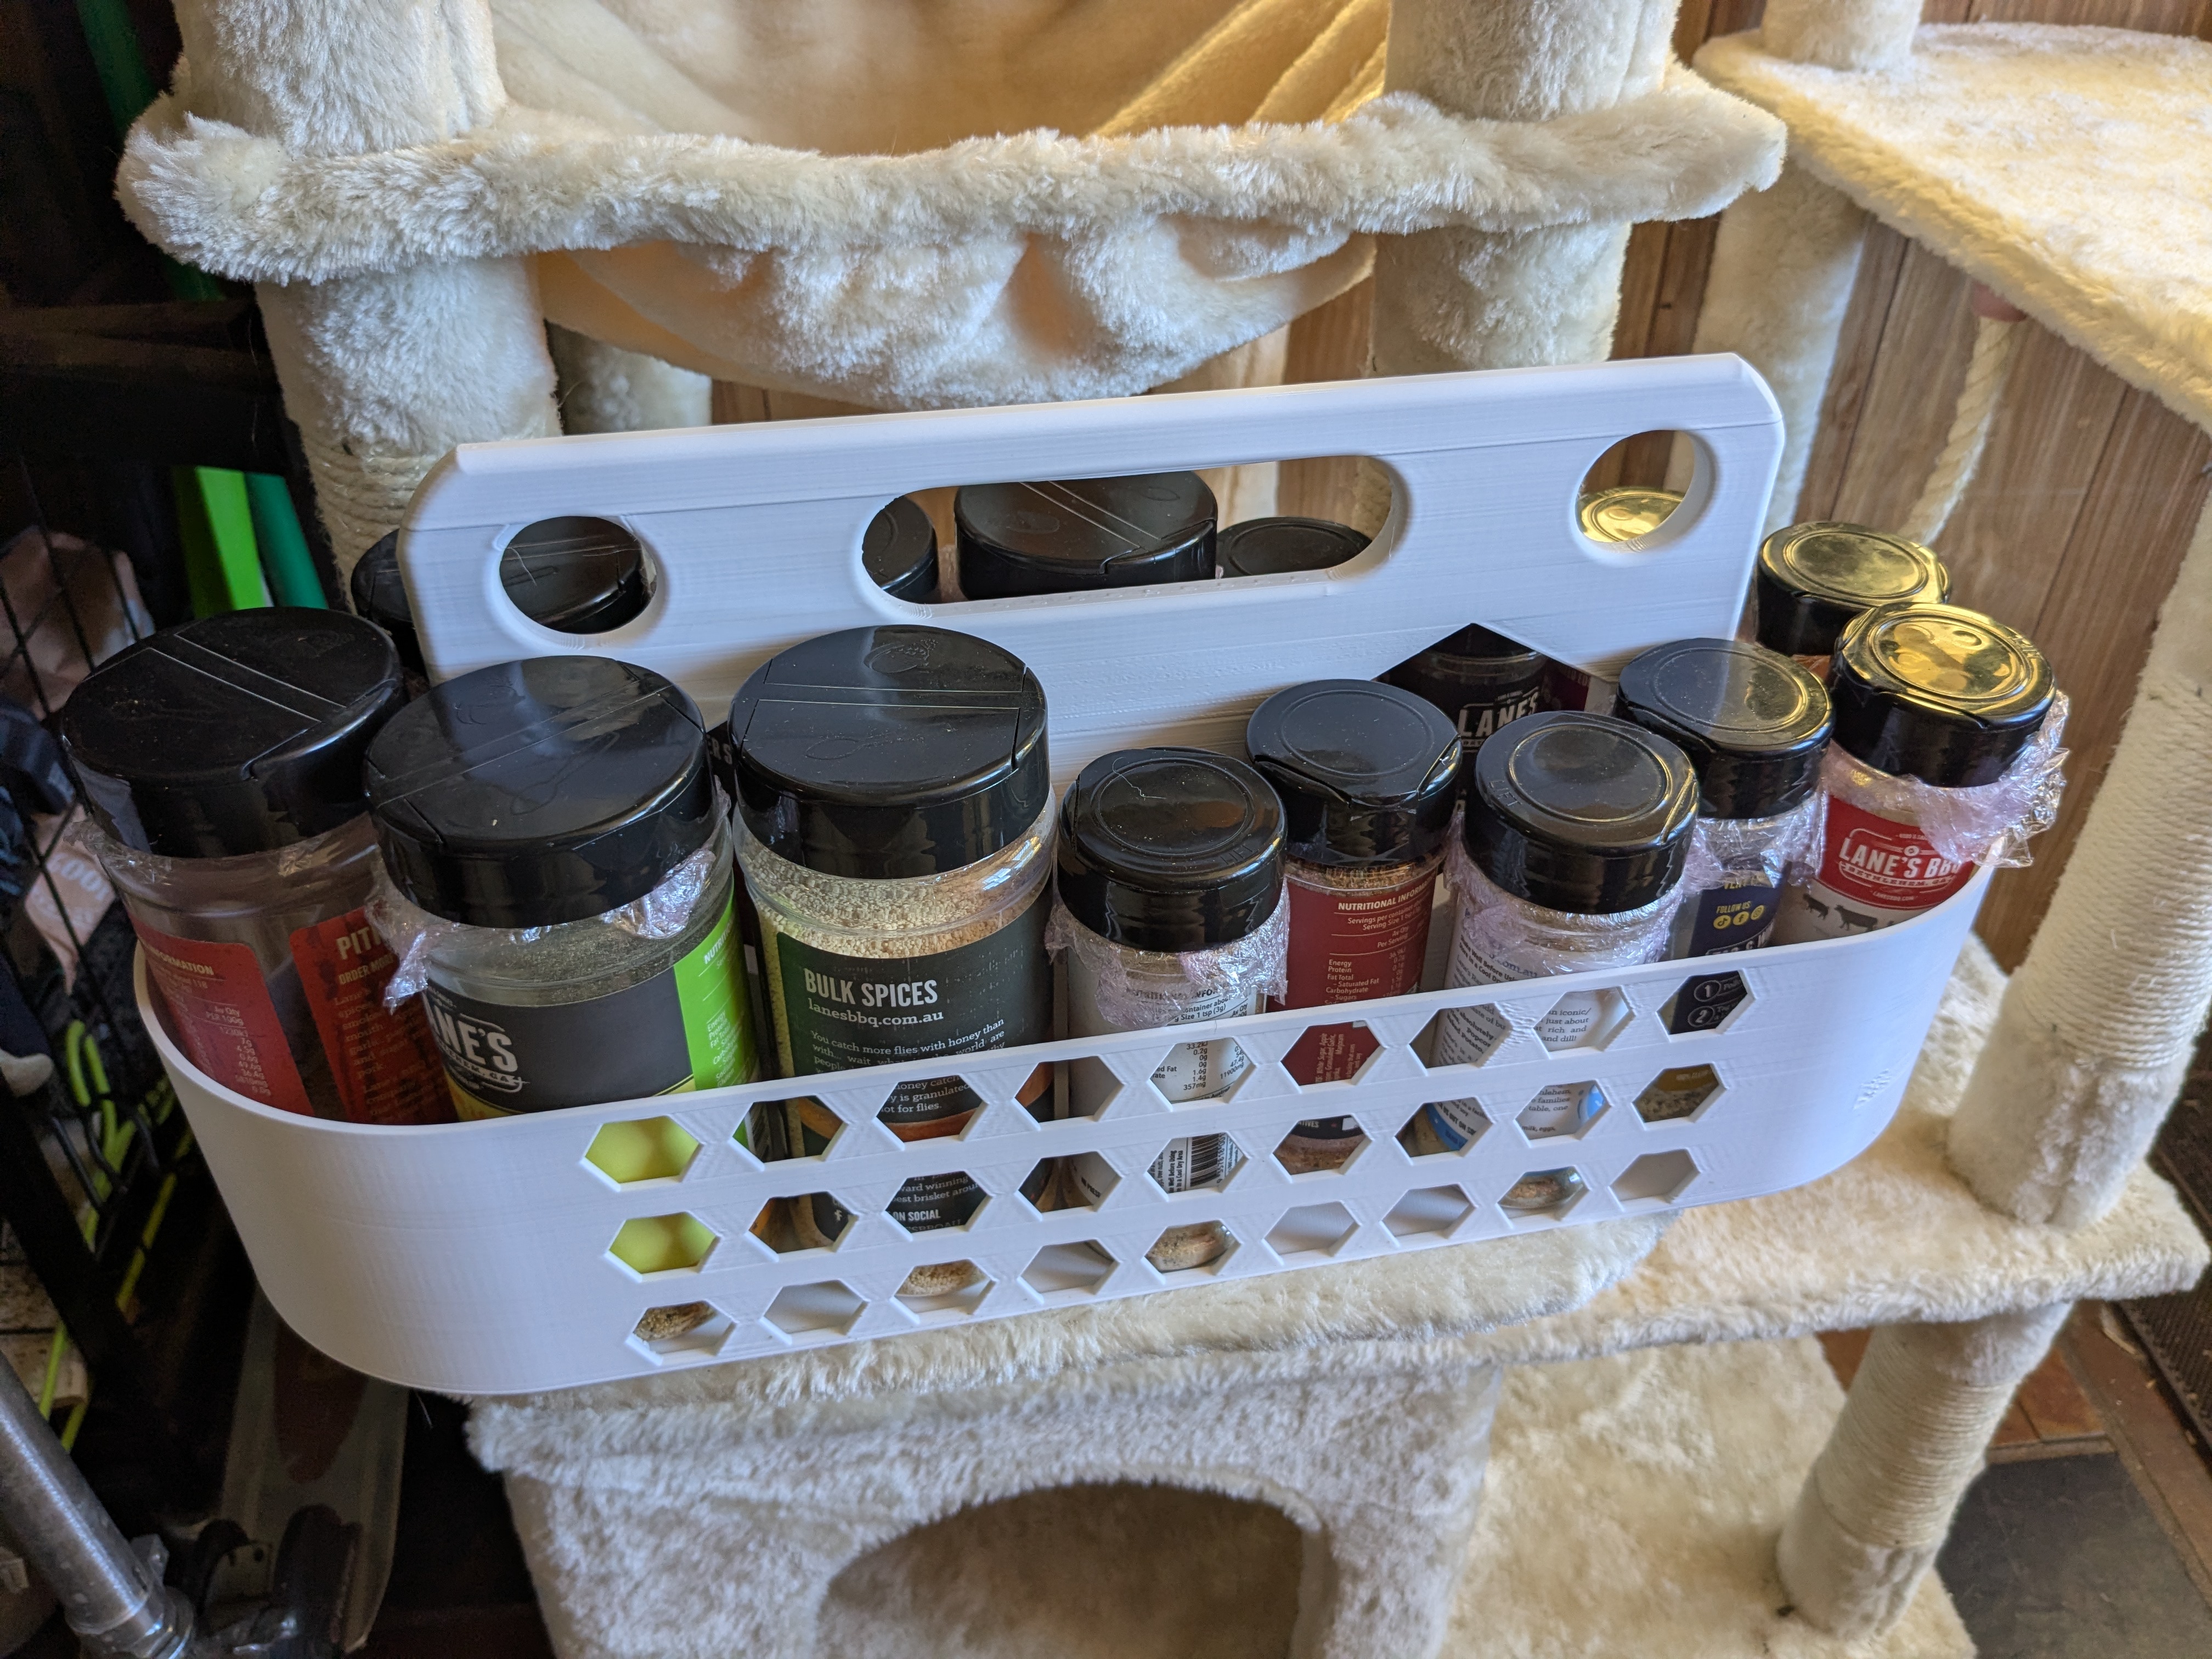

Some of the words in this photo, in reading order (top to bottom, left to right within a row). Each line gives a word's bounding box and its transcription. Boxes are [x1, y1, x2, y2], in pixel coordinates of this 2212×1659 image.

[1457, 691, 1539, 737] LANE'S
[1839, 837, 1921, 878] LANE'S
[1338, 897, 1397, 911] NUTRITIONAL
[1716, 903, 1741, 914] FOLLOW
[1742, 900, 1752, 910] US
[1362, 921, 1387, 930] Serving
[1387, 918, 1399, 926] Size
[1329, 959, 1352, 968] Energy
[1482, 961, 1503, 978] Before
[338, 967, 370, 985] ORDER
[1478, 966, 1491, 979] Cool
[804, 968, 856, 1005] BULK
[861, 979, 938, 1008] SPICES
[1338, 979, 1369, 988] Saturated
[1325, 987, 1369, 995] Carbohydrate
[1704, 985, 1711, 998] 1
[808, 998, 944, 1028] lanesbbq.com.au
[1180, 1012, 1195, 1020] Size
[1213, 1003, 1227, 1015] (3g)
[1695, 1009, 1708, 1023] 2
[1570, 1025, 1587, 1033] and
[431, 1005, 518, 1074] NE'S
[810, 1029, 830, 1045] You
[831, 1039, 860, 1053] catch
[862, 1046, 892, 1055] more
[894, 1045, 918, 1055] flies
[920, 1040, 946, 1053] with
[947, 1031, 981, 1050] honey
[983, 1018, 1005, 1035] than
[847, 1055, 871, 1065] wait
[955, 1039, 985, 1055] world
[990, 1030, 1005, 1043] are
[1183, 1082, 1206, 1091] 357mg
[900, 1093, 910, 1102] is
[897, 1104, 914, 1113] for
[1169, 1150, 1177, 1162] Using
[926, 1175, 969, 1190] winning
[914, 1192, 950, 1203] brisket
[908, 1209, 941, 1221] SOCIAL
